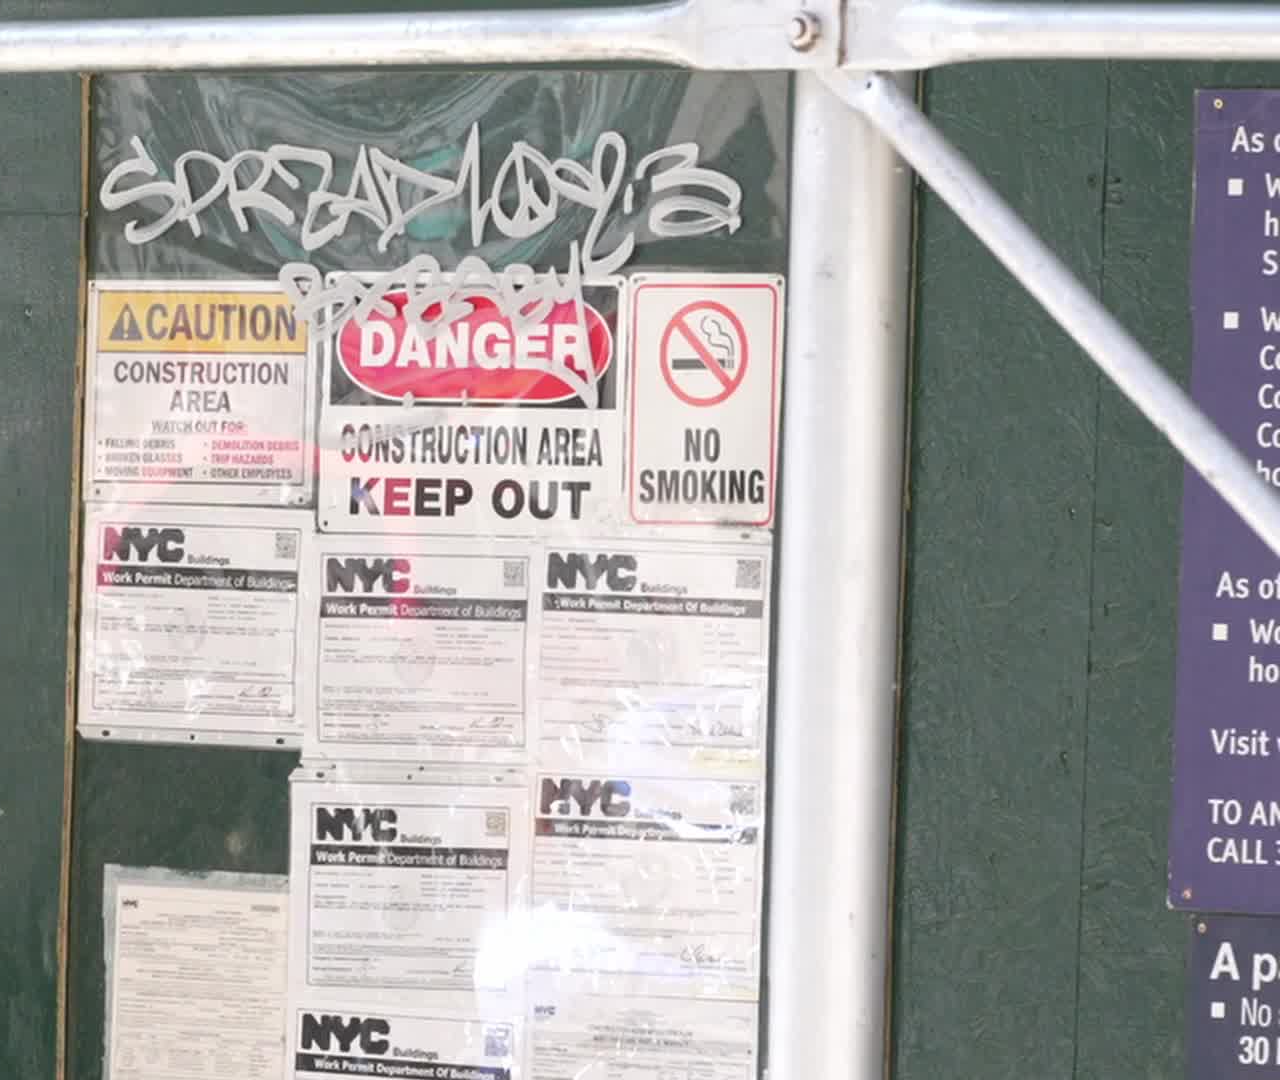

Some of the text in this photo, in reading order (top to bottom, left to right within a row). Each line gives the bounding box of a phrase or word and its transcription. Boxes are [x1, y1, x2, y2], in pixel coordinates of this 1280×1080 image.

[1231, 126, 1265, 153] As
[146, 303, 297, 342] CAUTION
[359, 321, 587, 371] DANGER
[113, 361, 289, 385] CONSTRUCTION
[169, 390, 231, 413] AREA
[195, 420, 218, 433] OUT
[340, 424, 603, 467] CONSTRUCTION AREA
[684, 428, 721, 463] NO
[350, 476, 591, 520] KEEP OUT
[640, 469, 765, 505] SMOKING
[103, 527, 230, 565] NYC Buildings
[103, 572, 132, 583] Work
[135, 573, 171, 585] Permit
[175, 574, 231, 587] Department
[234, 575, 244, 586] of
[326, 558, 457, 595] NYC Buildings
[547, 552, 688, 595] NYC Buildings
[1216, 571, 1249, 599] As
[326, 604, 521, 620] Work Permit Department of Buildings
[1211, 728, 1269, 756] Visit
[540, 778, 631, 817] NYC
[1208, 798, 1241, 825] TO
[316, 808, 397, 842] NYC
[316, 852, 345, 863] Work
[1206, 837, 1268, 865] CALL
[1210, 942, 1240, 980] A
[1240, 997, 1271, 1027] No
[301, 1014, 438, 1060] NYC Buildings
[1239, 1036, 1269, 1065] 30
[314, 1059, 339, 1070] Work
[342, 1060, 374, 1073] Permit
[376, 1063, 434, 1078] Department
[437, 1066, 448, 1077] Of
